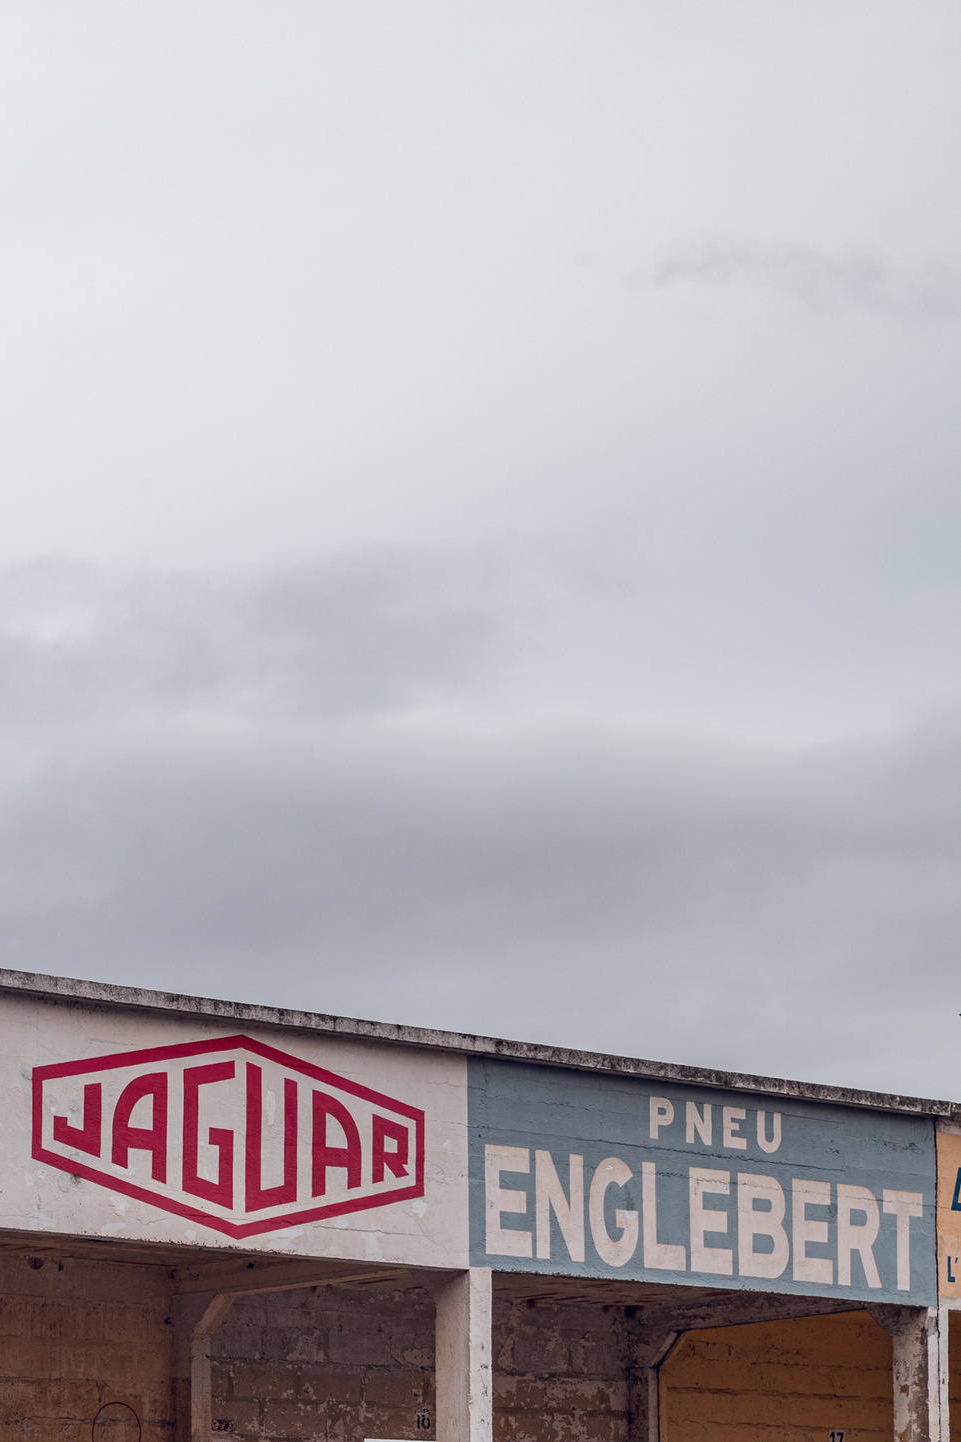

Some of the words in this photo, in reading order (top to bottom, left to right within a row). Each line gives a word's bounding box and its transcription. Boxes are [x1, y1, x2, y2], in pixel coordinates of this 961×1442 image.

[53, 1060, 409, 1213] JAGUAR
[648, 1095, 783, 1154] PNEU
[484, 1143, 924, 1292] ENGLEBERT
